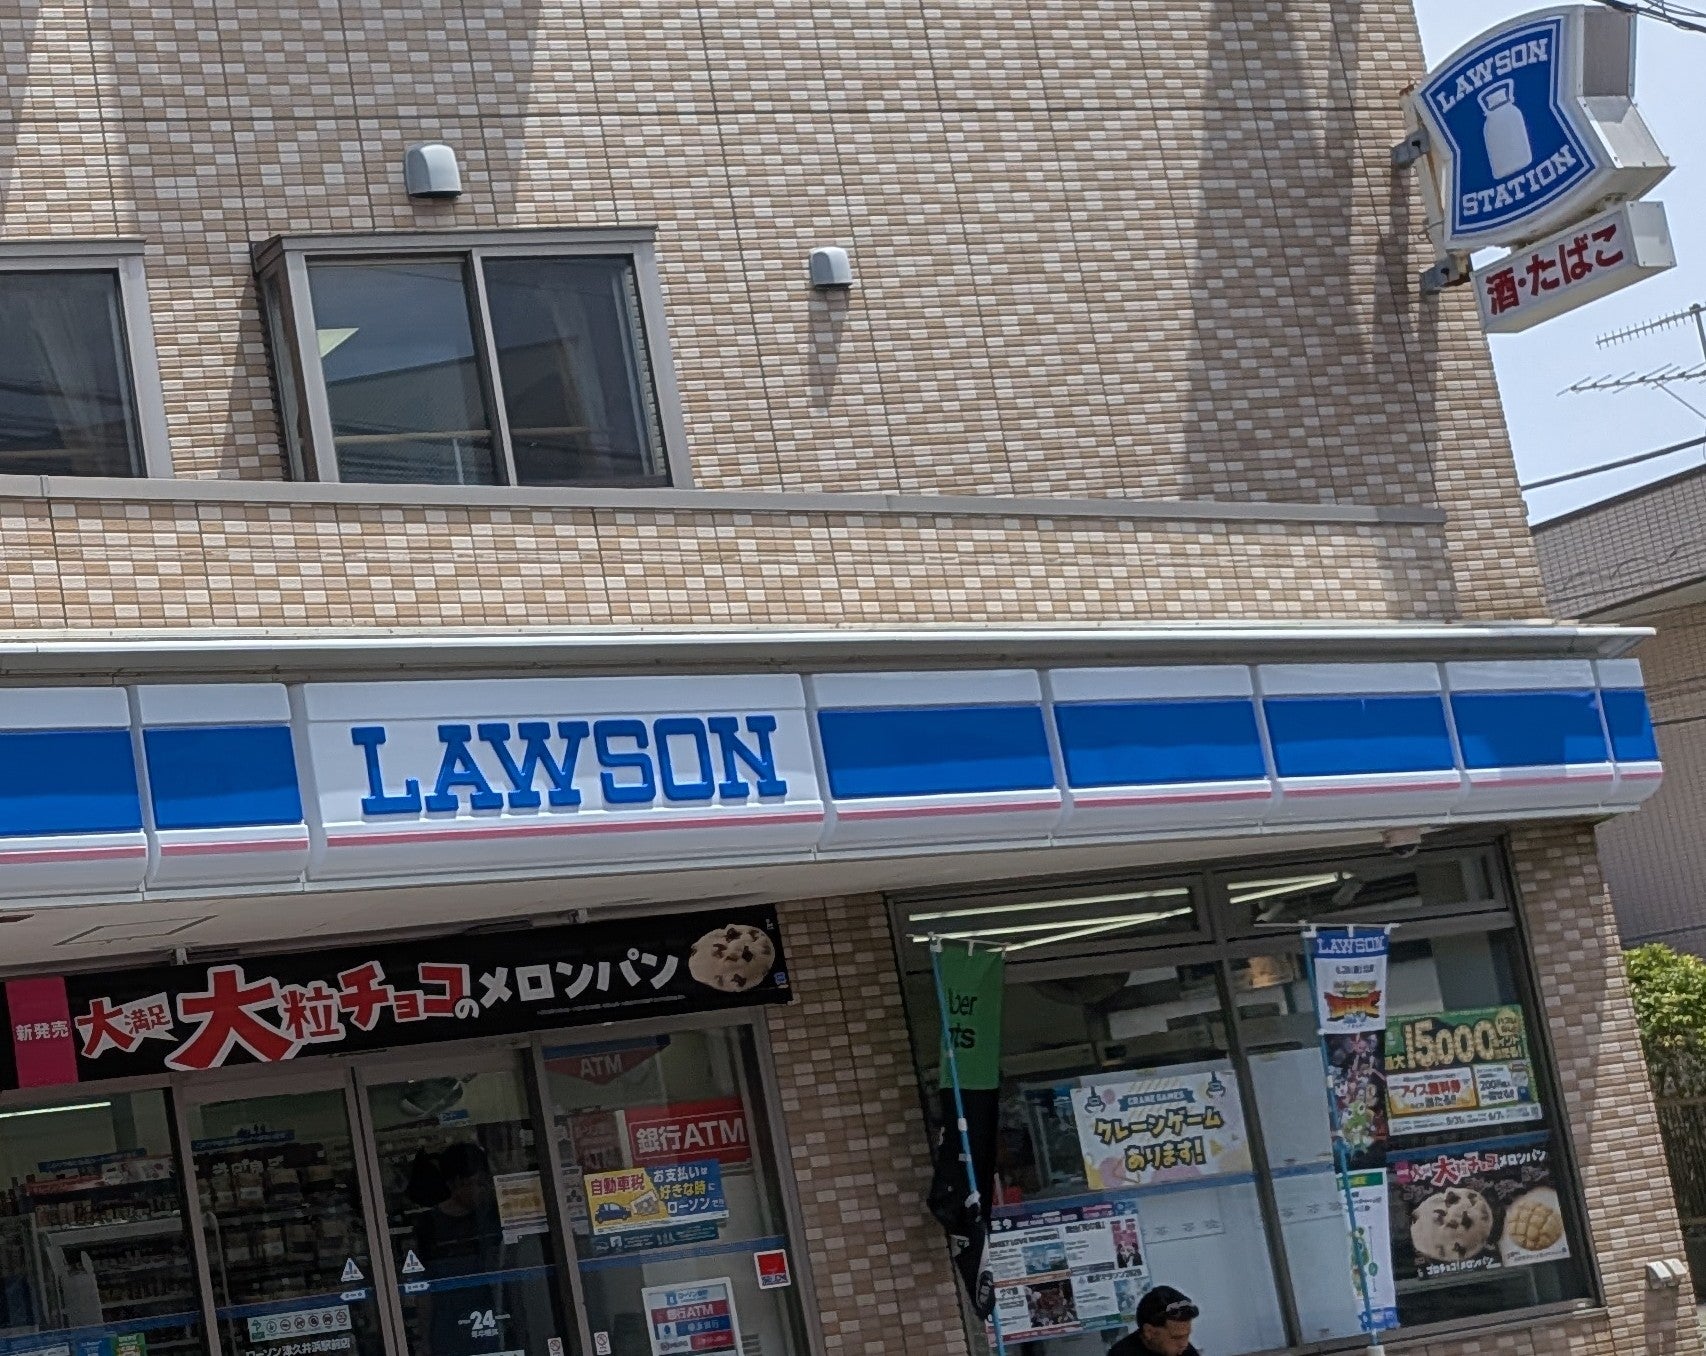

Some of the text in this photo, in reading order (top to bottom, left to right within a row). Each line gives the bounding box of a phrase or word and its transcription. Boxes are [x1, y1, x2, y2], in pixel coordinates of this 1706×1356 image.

[1435, 38, 1549, 114] LAWSON
[1462, 145, 1577, 216] STATION
[1486, 224, 1624, 315] 酒・たばこ
[351, 715, 788, 816] LAWSON
[1316, 935, 1385, 954] LAWSON
[948, 987, 977, 1016] ber
[15, 1020, 70, 1043] 新発売
[580, 1054, 623, 1078] ATM
[636, 1117, 745, 1154] 銀行ATM
[1094, 1105, 1224, 1145] クレーンゲーム
[470, 1309, 497, 1330] 24
